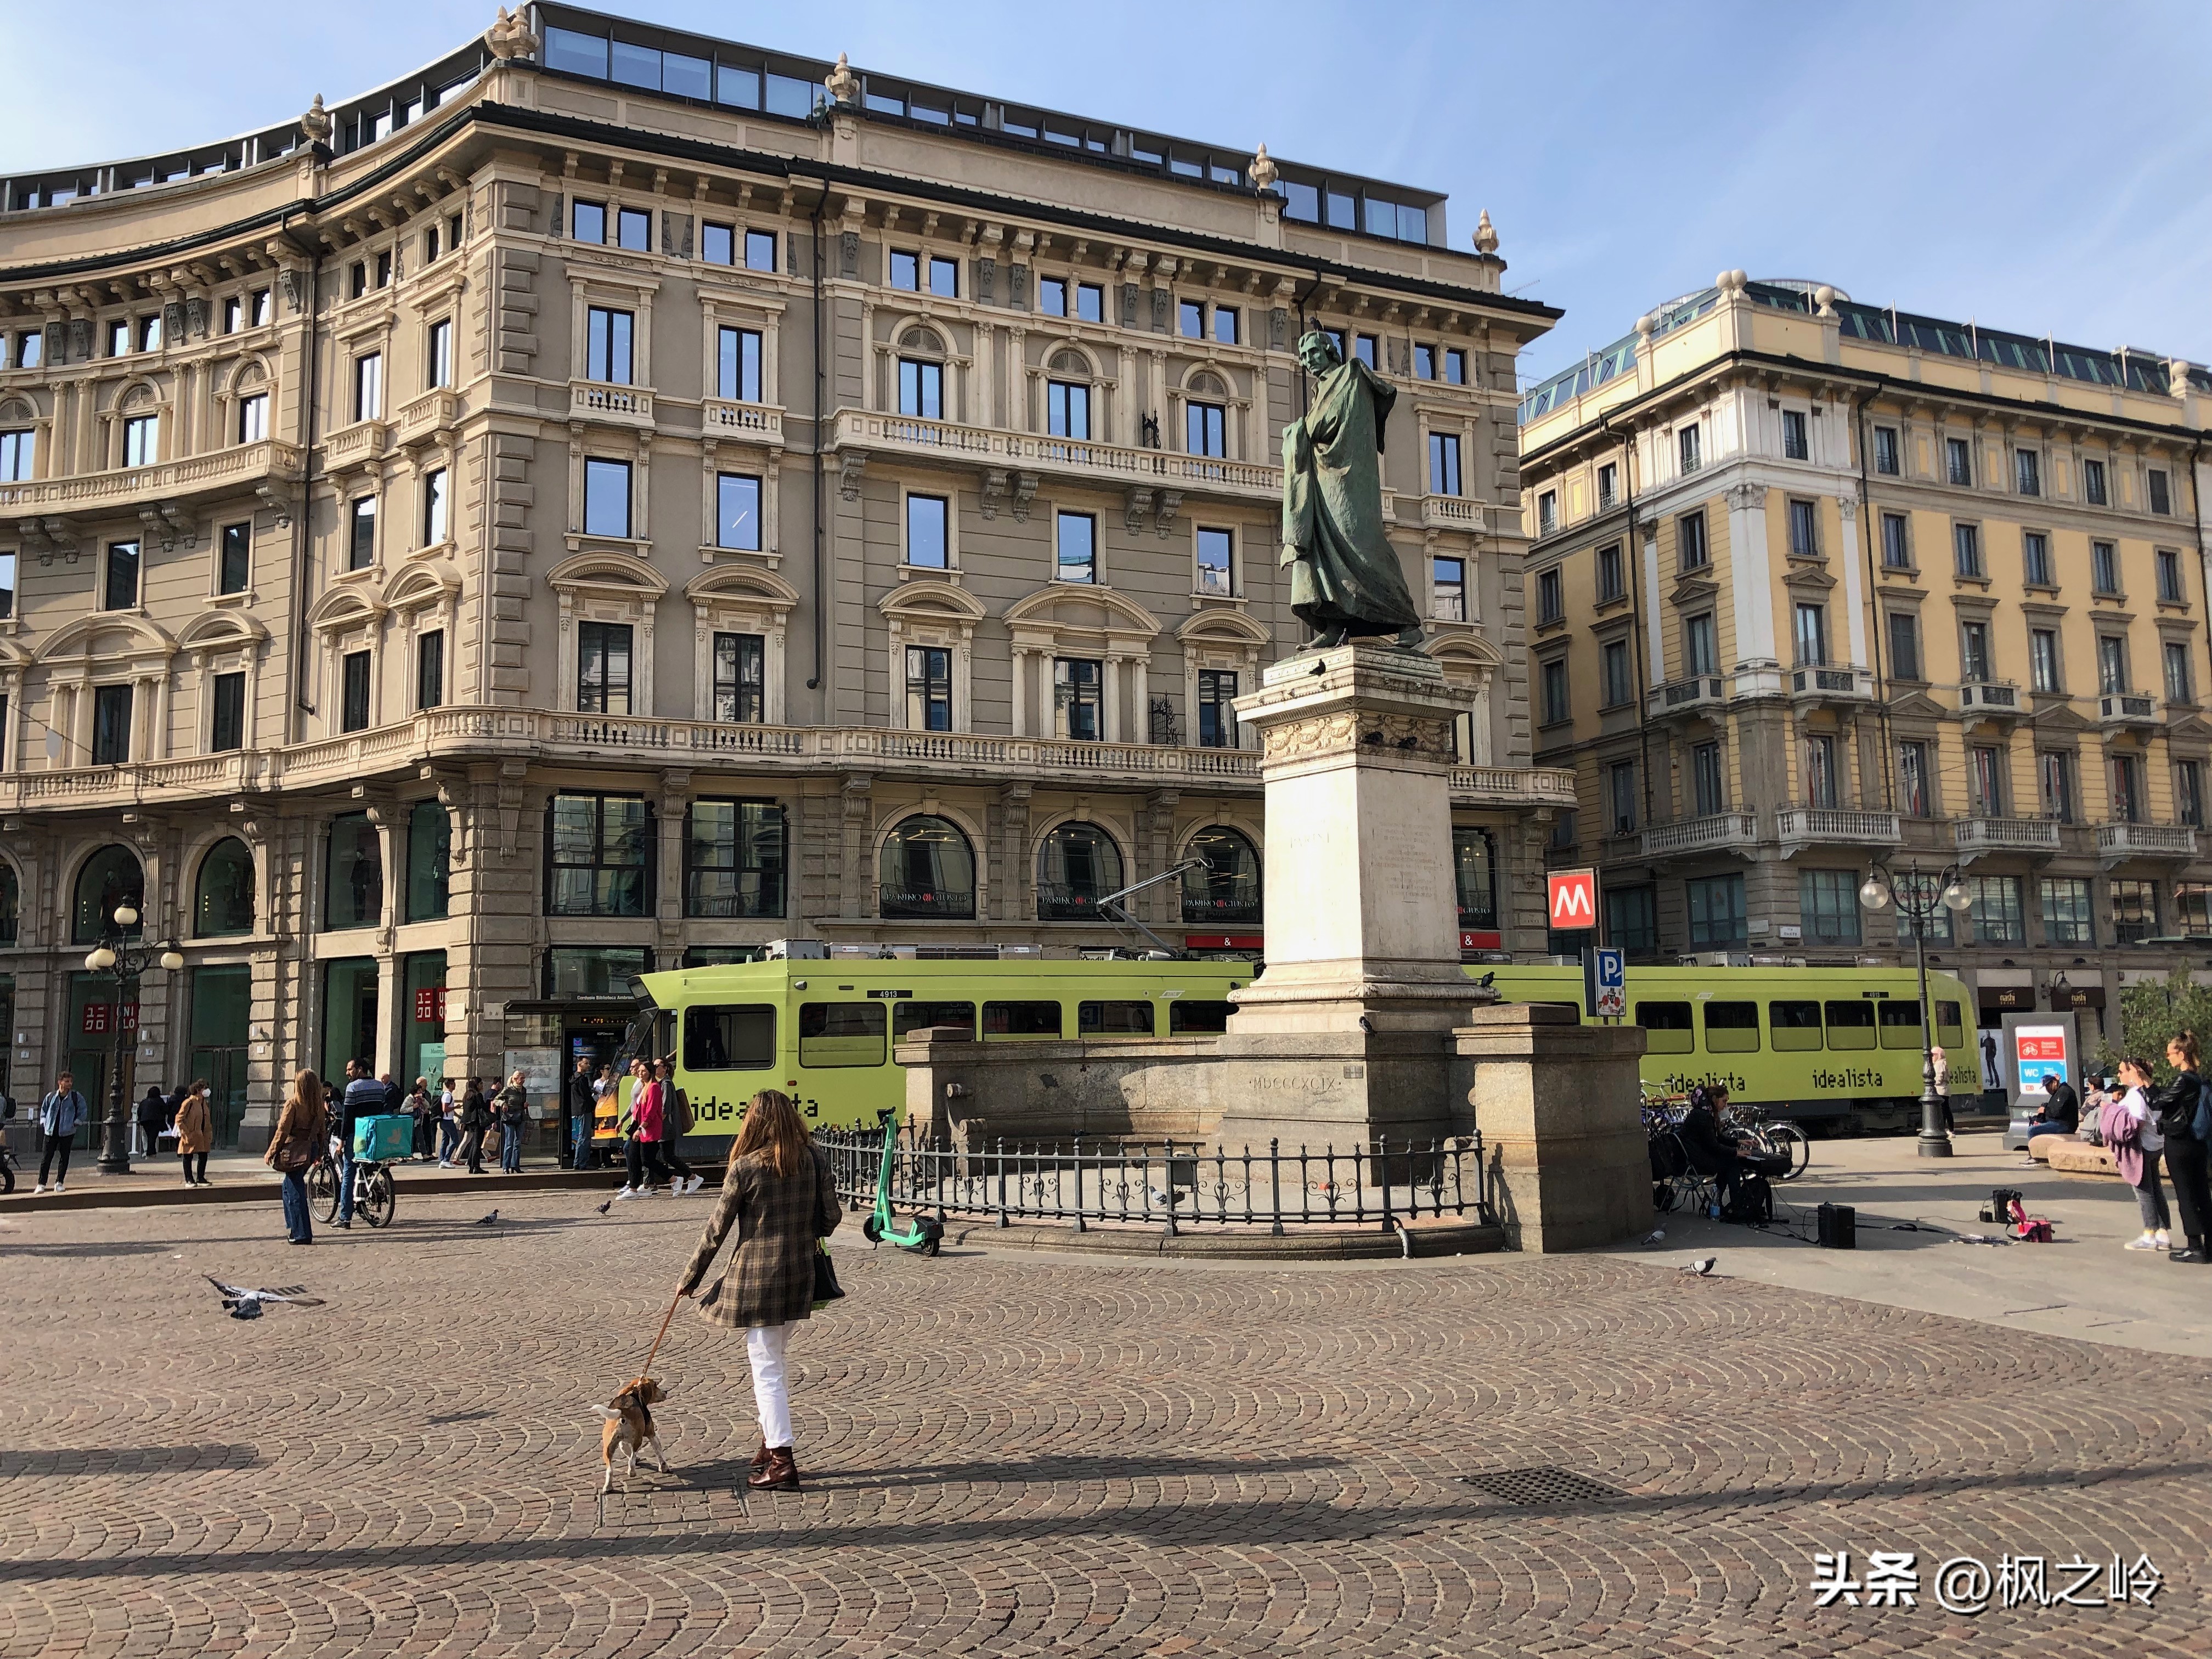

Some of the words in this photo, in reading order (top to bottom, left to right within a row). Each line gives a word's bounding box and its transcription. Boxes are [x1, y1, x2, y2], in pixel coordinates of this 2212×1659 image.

[886, 893, 922, 902] PANINO
[932, 894, 967, 902] GIUSTO
[1042, 896, 1074, 905] PANINO
[1554, 884, 1591, 917] M
[1224, 937, 1231, 946] &
[1465, 935, 1473, 946] &
[1604, 956, 1617, 982] P
[1812, 1068, 1883, 1088] idealista
[2024, 1068, 2039, 1077] WC
[691, 1093, 818, 1121] ideata
